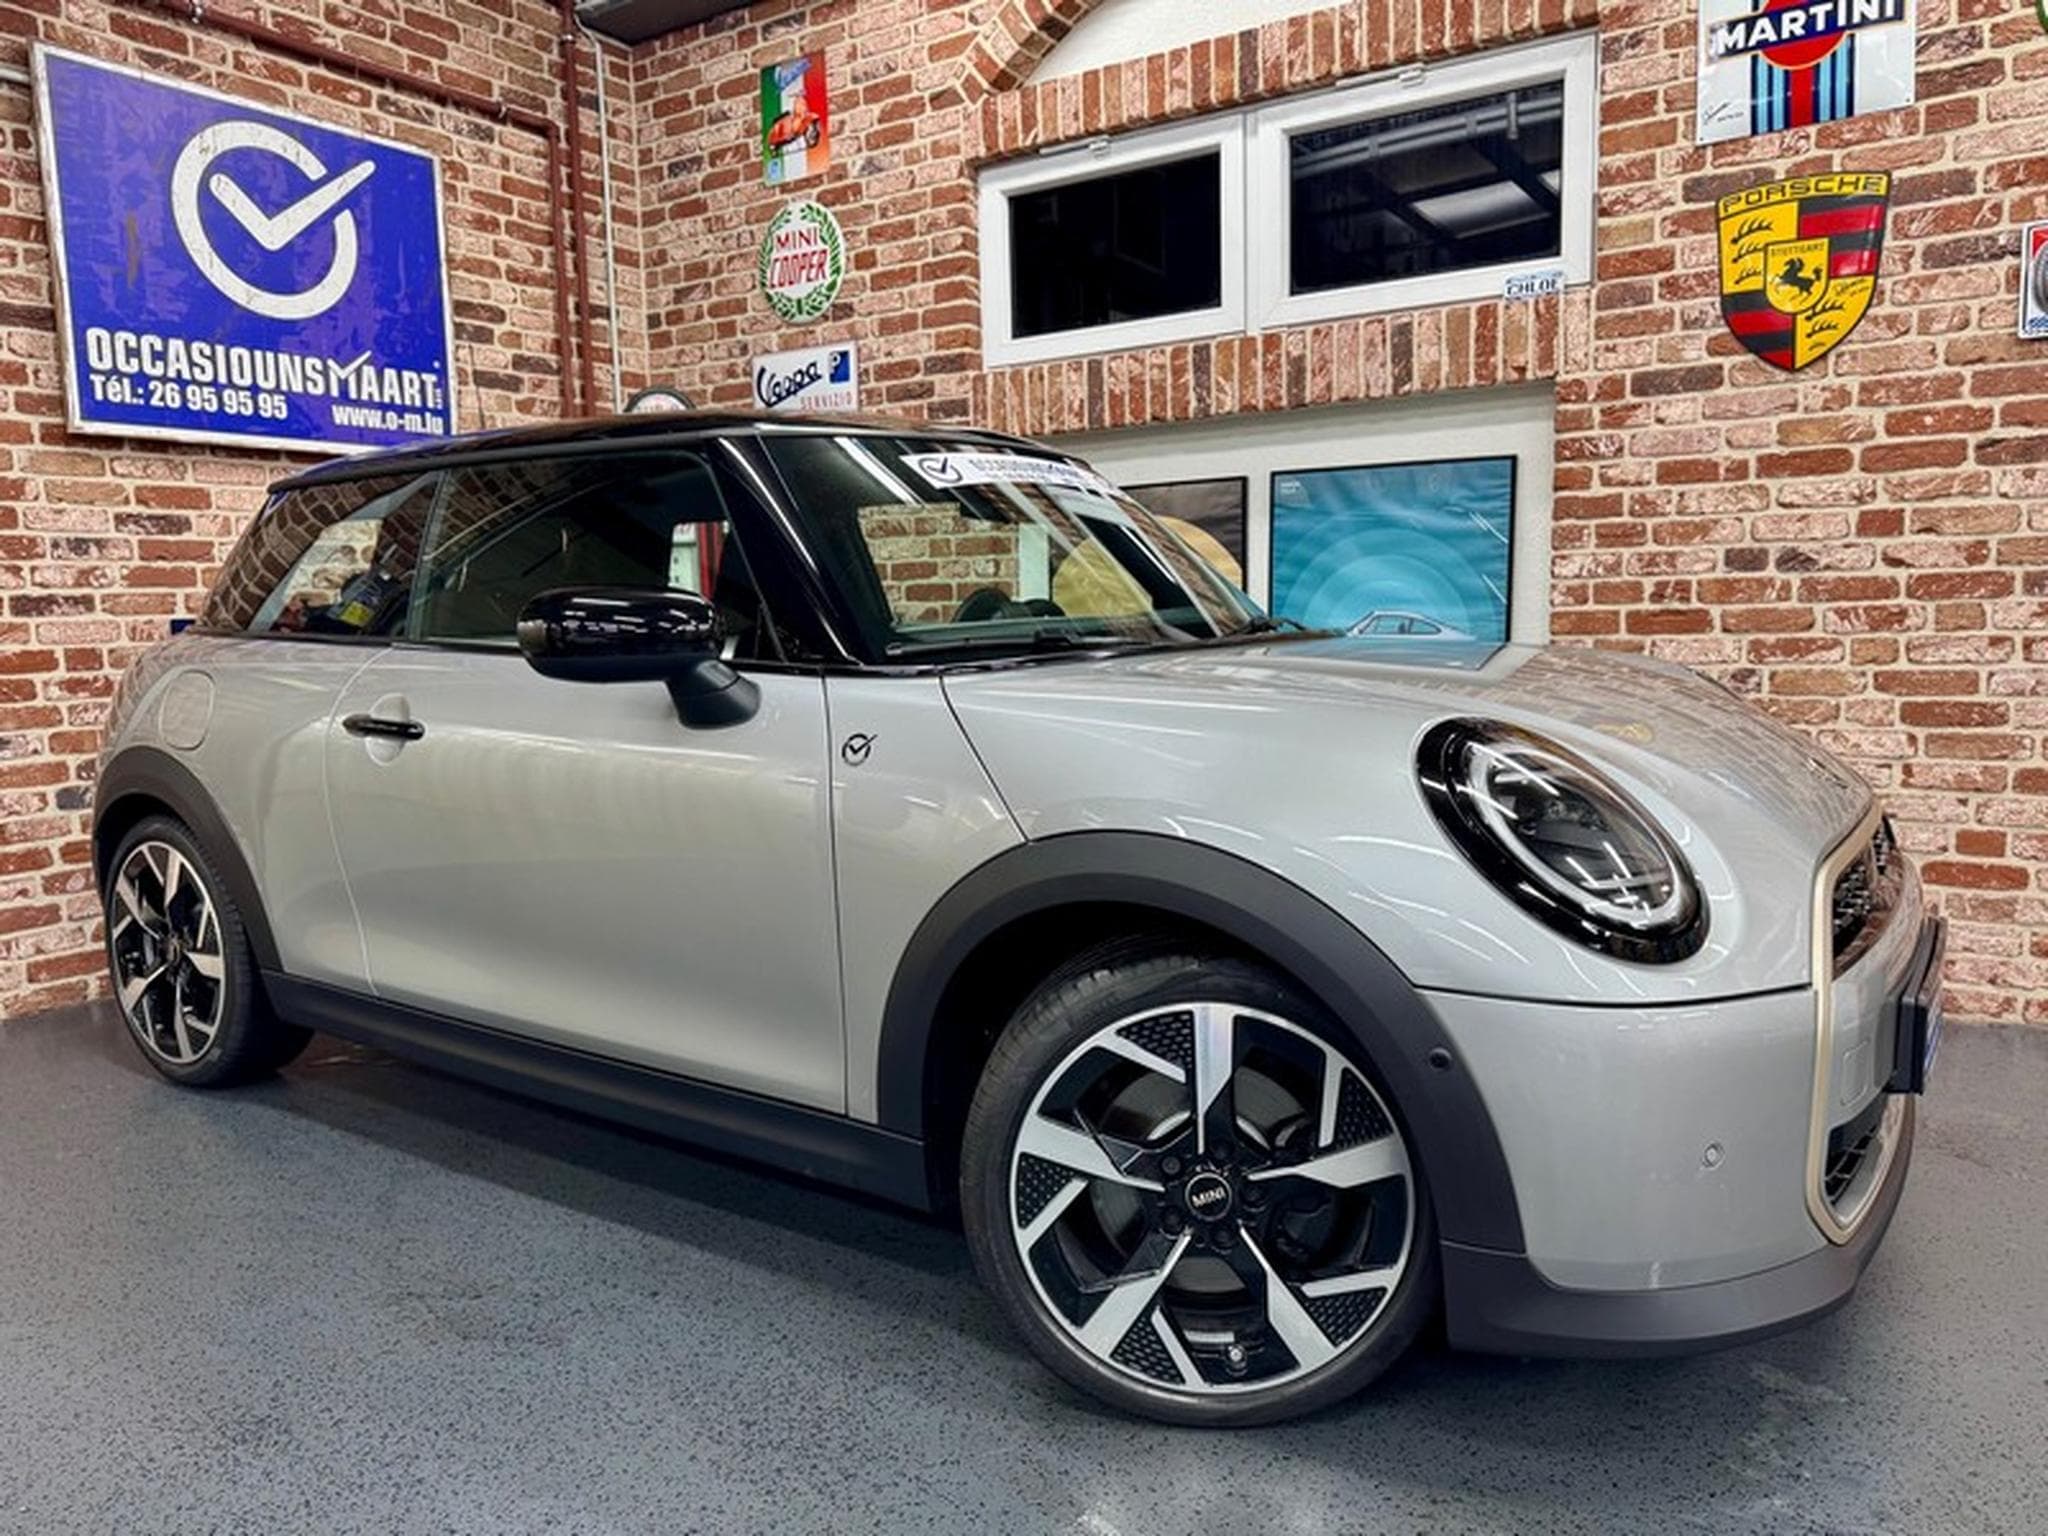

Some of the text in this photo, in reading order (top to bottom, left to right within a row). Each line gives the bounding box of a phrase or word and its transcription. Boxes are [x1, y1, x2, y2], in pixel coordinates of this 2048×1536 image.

[1712, 0, 1897, 55] MARTINI
[1722, 176, 1884, 214] PORSCHE
[776, 226, 818, 251] MINI
[769, 248, 828, 289] COOPER
[85, 327, 438, 409] OCCASIOUNSMAART
[757, 361, 822, 408] Vespa
[89, 373, 288, 420] Tél.: 26 95 95 95
[331, 404, 444, 435] www.o-m.lu
[1191, 1186, 1226, 1208] MINI
